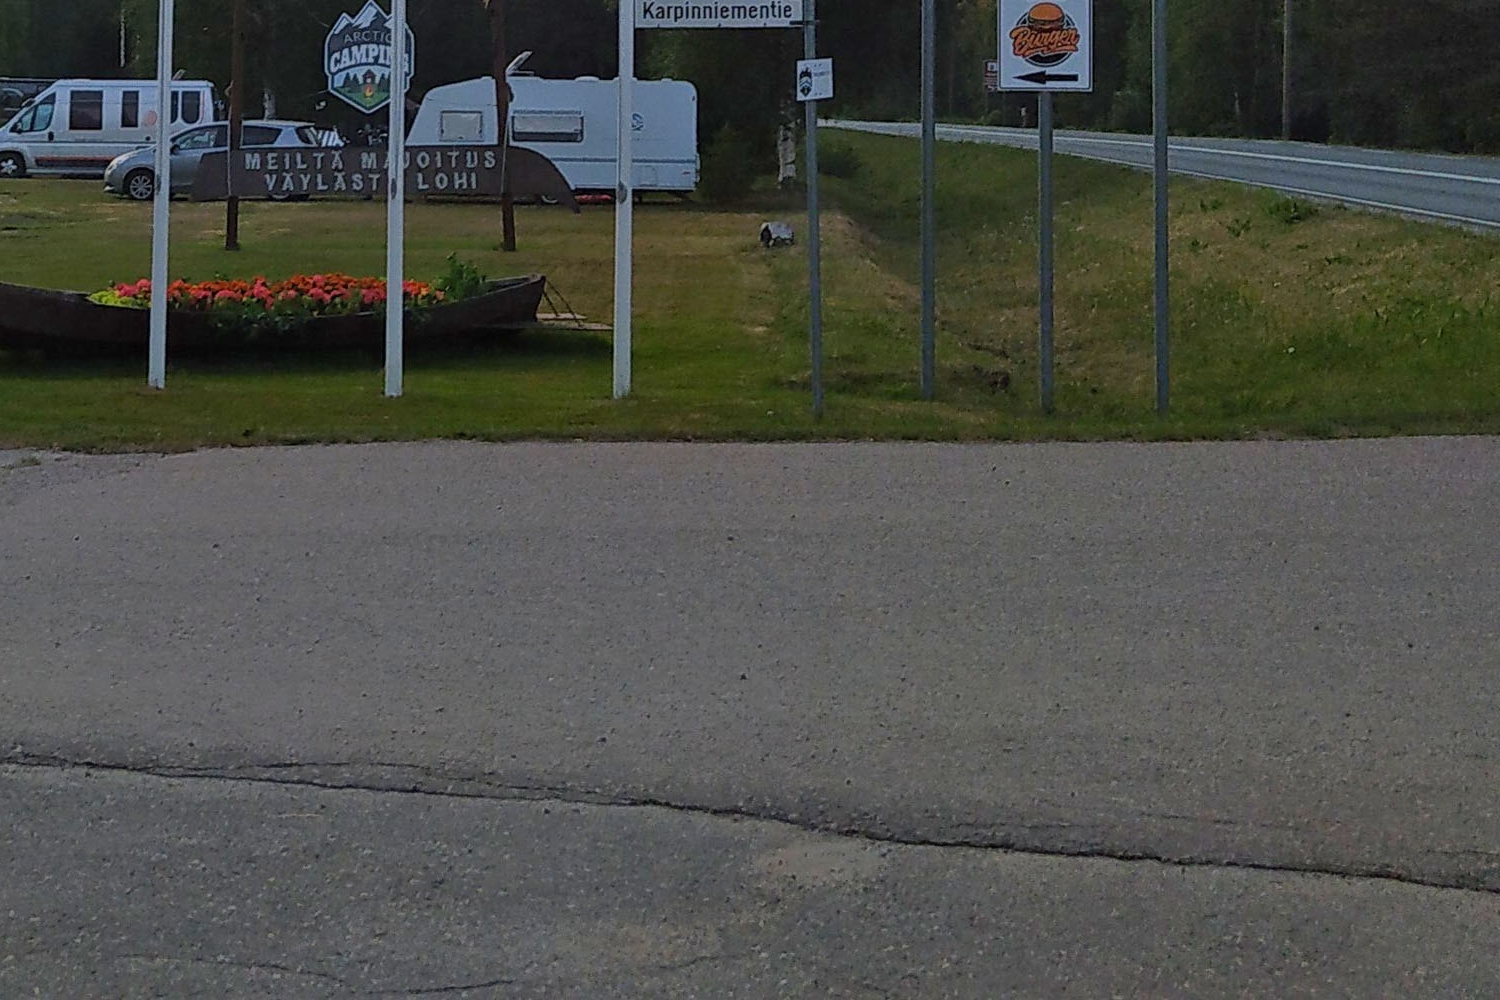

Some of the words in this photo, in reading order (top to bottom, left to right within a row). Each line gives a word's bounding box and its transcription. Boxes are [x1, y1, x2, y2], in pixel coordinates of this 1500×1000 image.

[643, 1, 792, 22] Karpinniementie
[1010, 26, 1079, 58] Burger
[245, 150, 343, 170] MEILTÄ
[417, 172, 477, 190] LOHI
